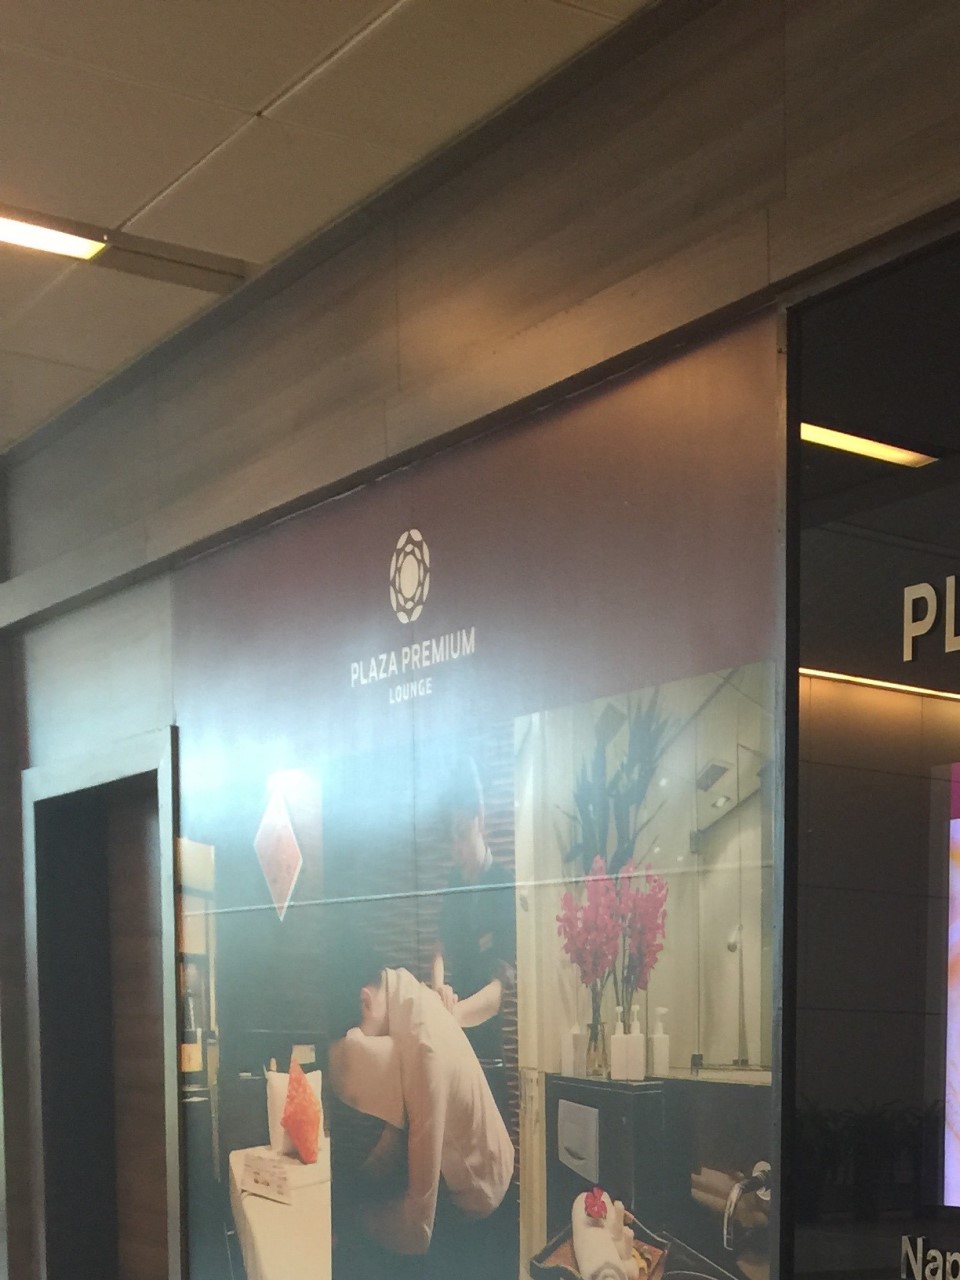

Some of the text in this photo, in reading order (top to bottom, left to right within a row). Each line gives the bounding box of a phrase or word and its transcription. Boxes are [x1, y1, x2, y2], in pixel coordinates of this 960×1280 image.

[351, 626, 475, 688] PLAZA PREMIUM
[389, 677, 432, 704] LOUNGE
